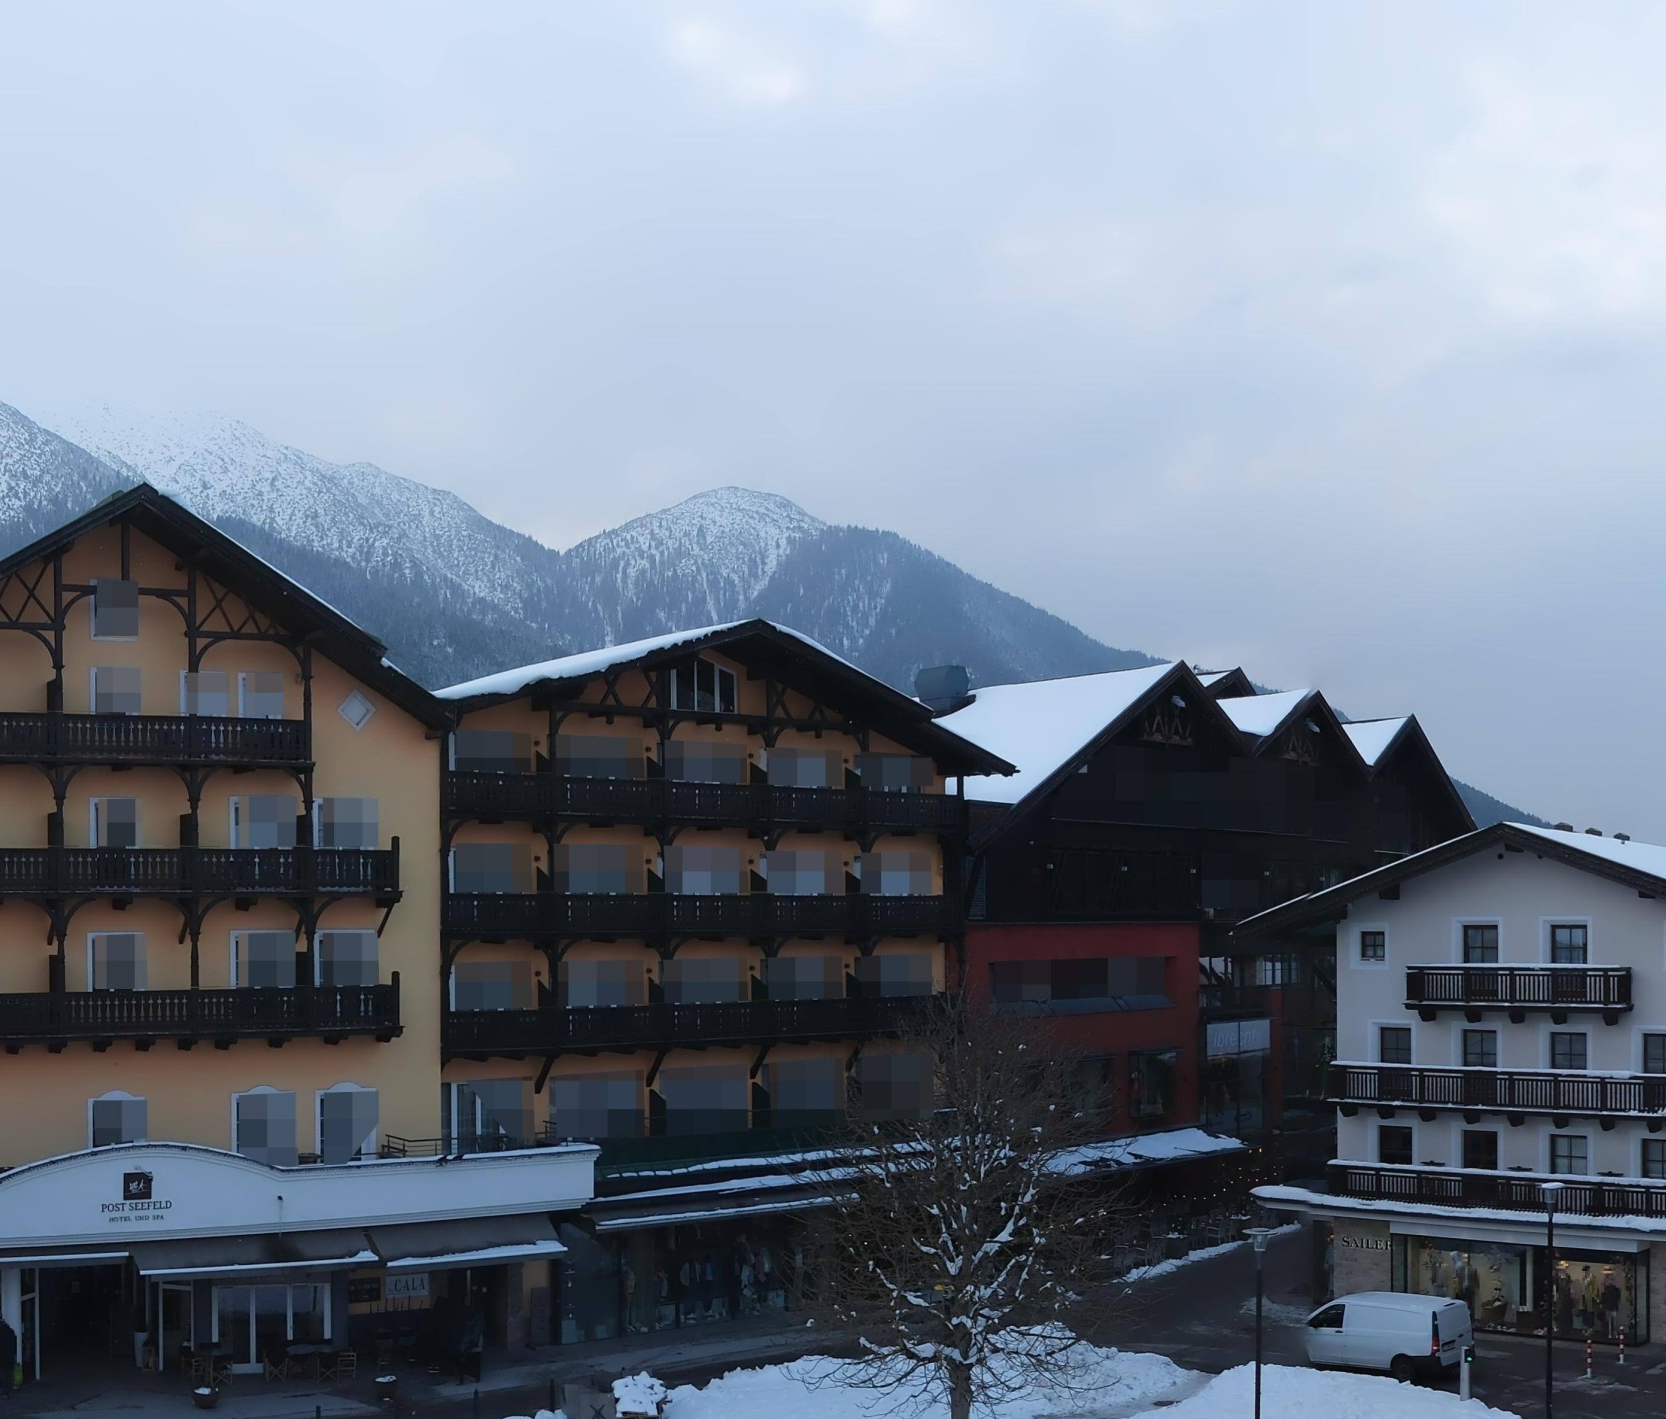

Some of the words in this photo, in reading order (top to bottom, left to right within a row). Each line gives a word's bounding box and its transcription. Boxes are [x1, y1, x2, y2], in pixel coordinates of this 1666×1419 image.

[101, 1202, 127, 1213] POST
[128, 1200, 172, 1212] SEEFELD
[109, 1215, 132, 1223] HOTEL
[134, 1214, 150, 1222] UND
